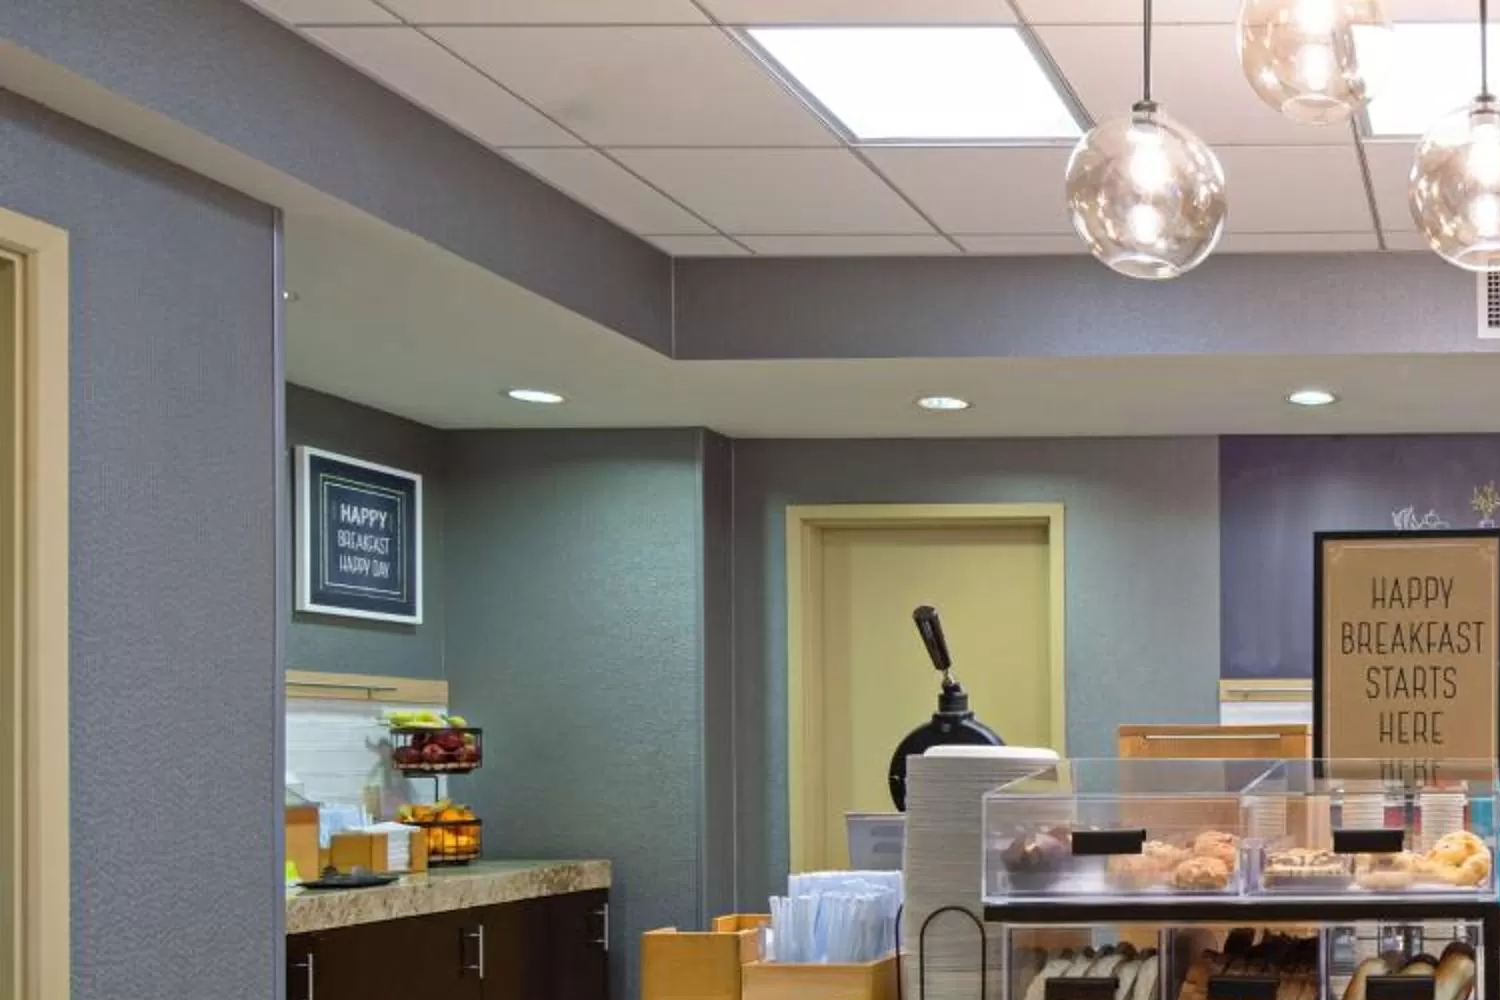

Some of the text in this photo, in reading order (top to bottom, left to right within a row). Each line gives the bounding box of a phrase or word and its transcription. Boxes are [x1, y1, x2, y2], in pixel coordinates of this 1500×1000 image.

[341, 503, 387, 529] HAPPY
[337, 529, 391, 555] BREAKFAST
[339, 554, 391, 579] HAPPY DAY
[1371, 576, 1454, 609] HAPPY
[1341, 621, 1485, 655] BREAKFAST
[1366, 665, 1457, 699] STARTS
[1379, 711, 1444, 745] HERE
